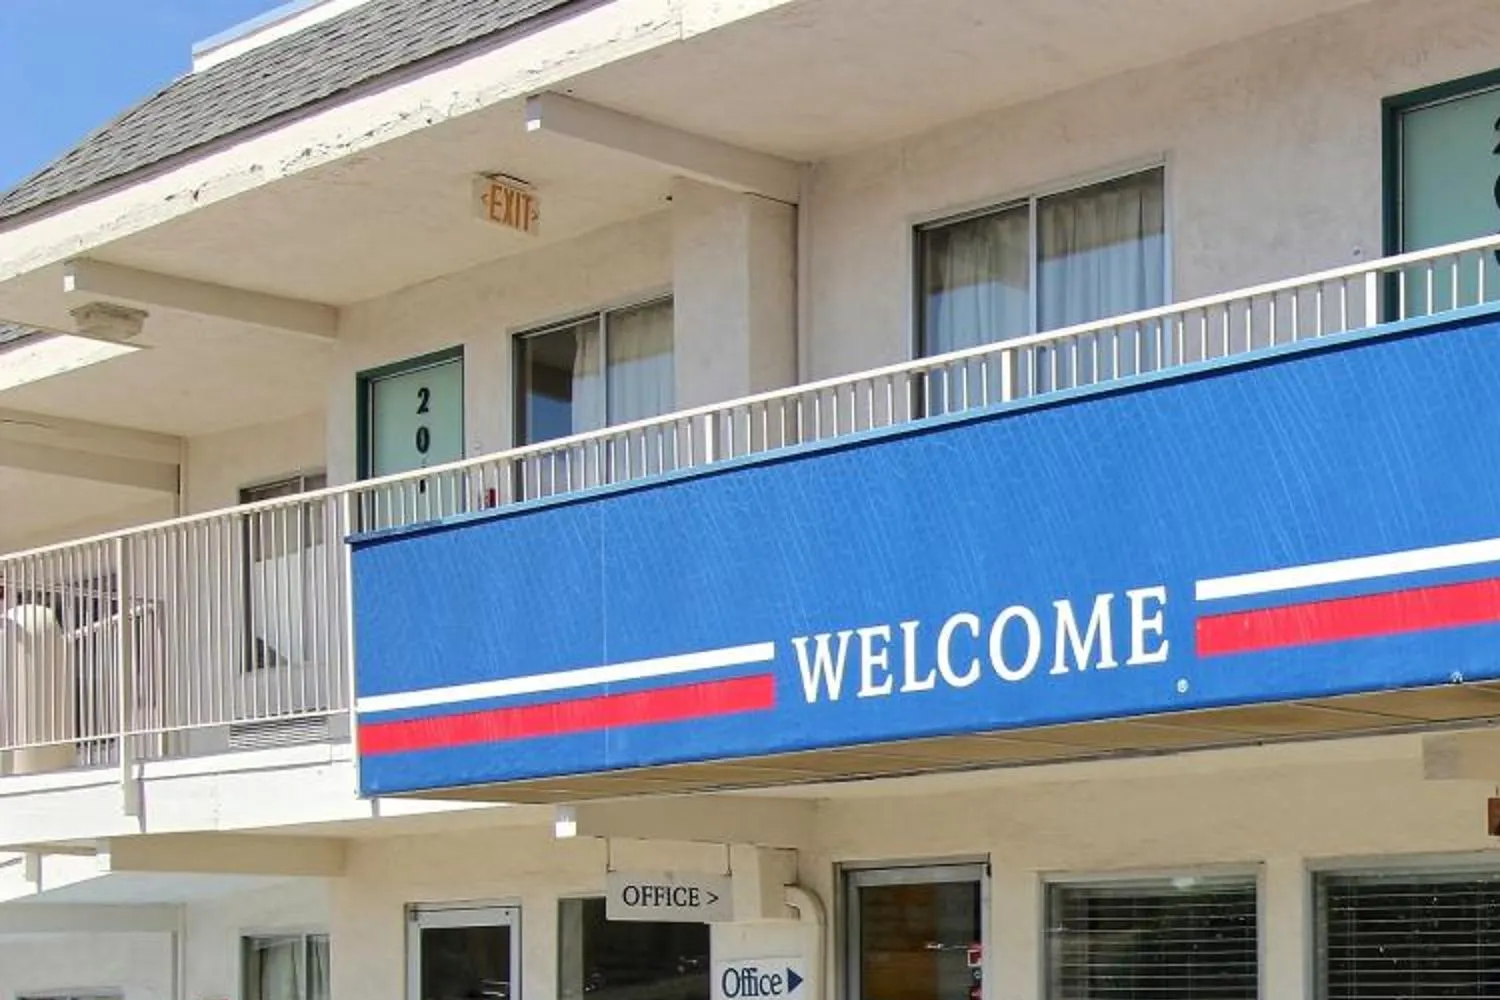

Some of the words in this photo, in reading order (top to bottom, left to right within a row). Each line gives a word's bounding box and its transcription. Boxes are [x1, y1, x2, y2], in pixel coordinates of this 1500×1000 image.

[489, 184, 532, 232] EXIT
[791, 584, 1170, 704] WELCOME
[622, 885, 701, 908] OFFICE
[721, 967, 783, 999] Office
